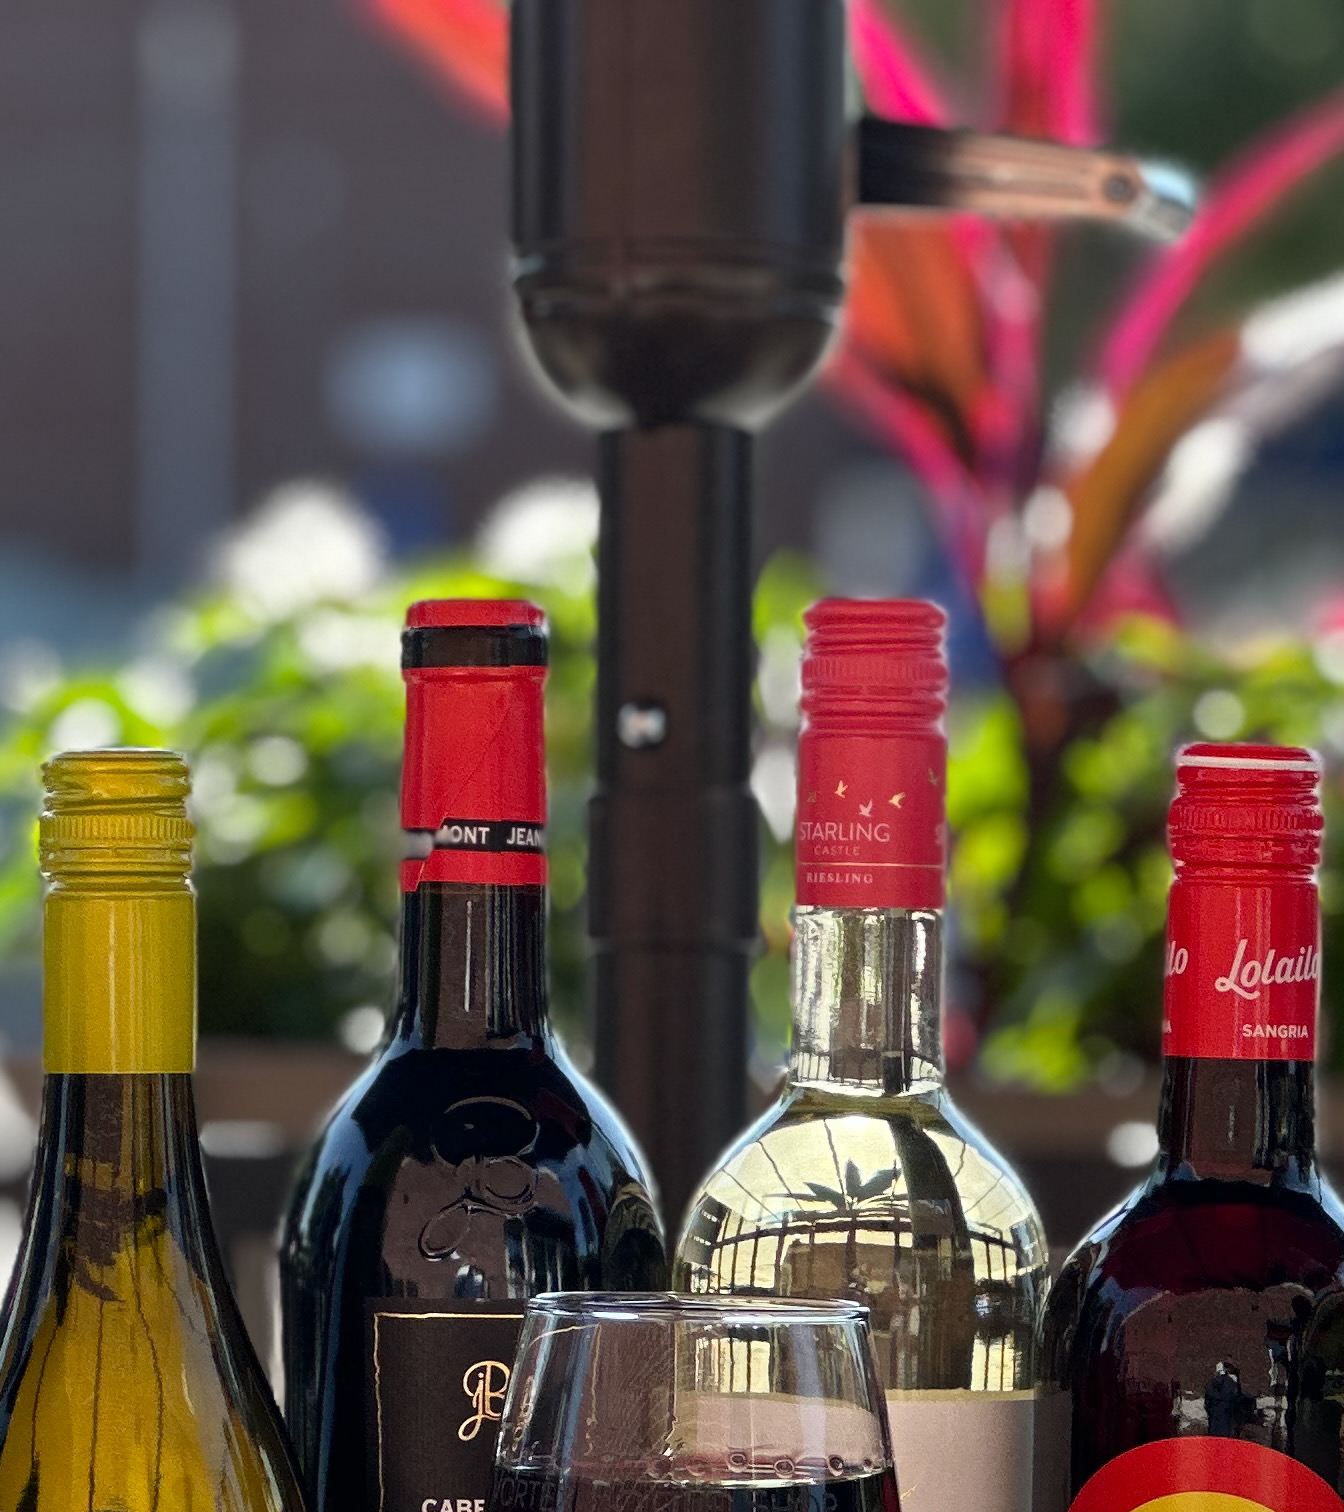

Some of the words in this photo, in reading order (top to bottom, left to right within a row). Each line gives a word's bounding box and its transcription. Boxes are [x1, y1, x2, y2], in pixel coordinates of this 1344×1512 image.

[800, 821, 891, 843] STARLING
[813, 844, 861, 857] CASTLE
[806, 872, 874, 885] RIESLING
[1242, 1022, 1309, 1039] SANGRIA
